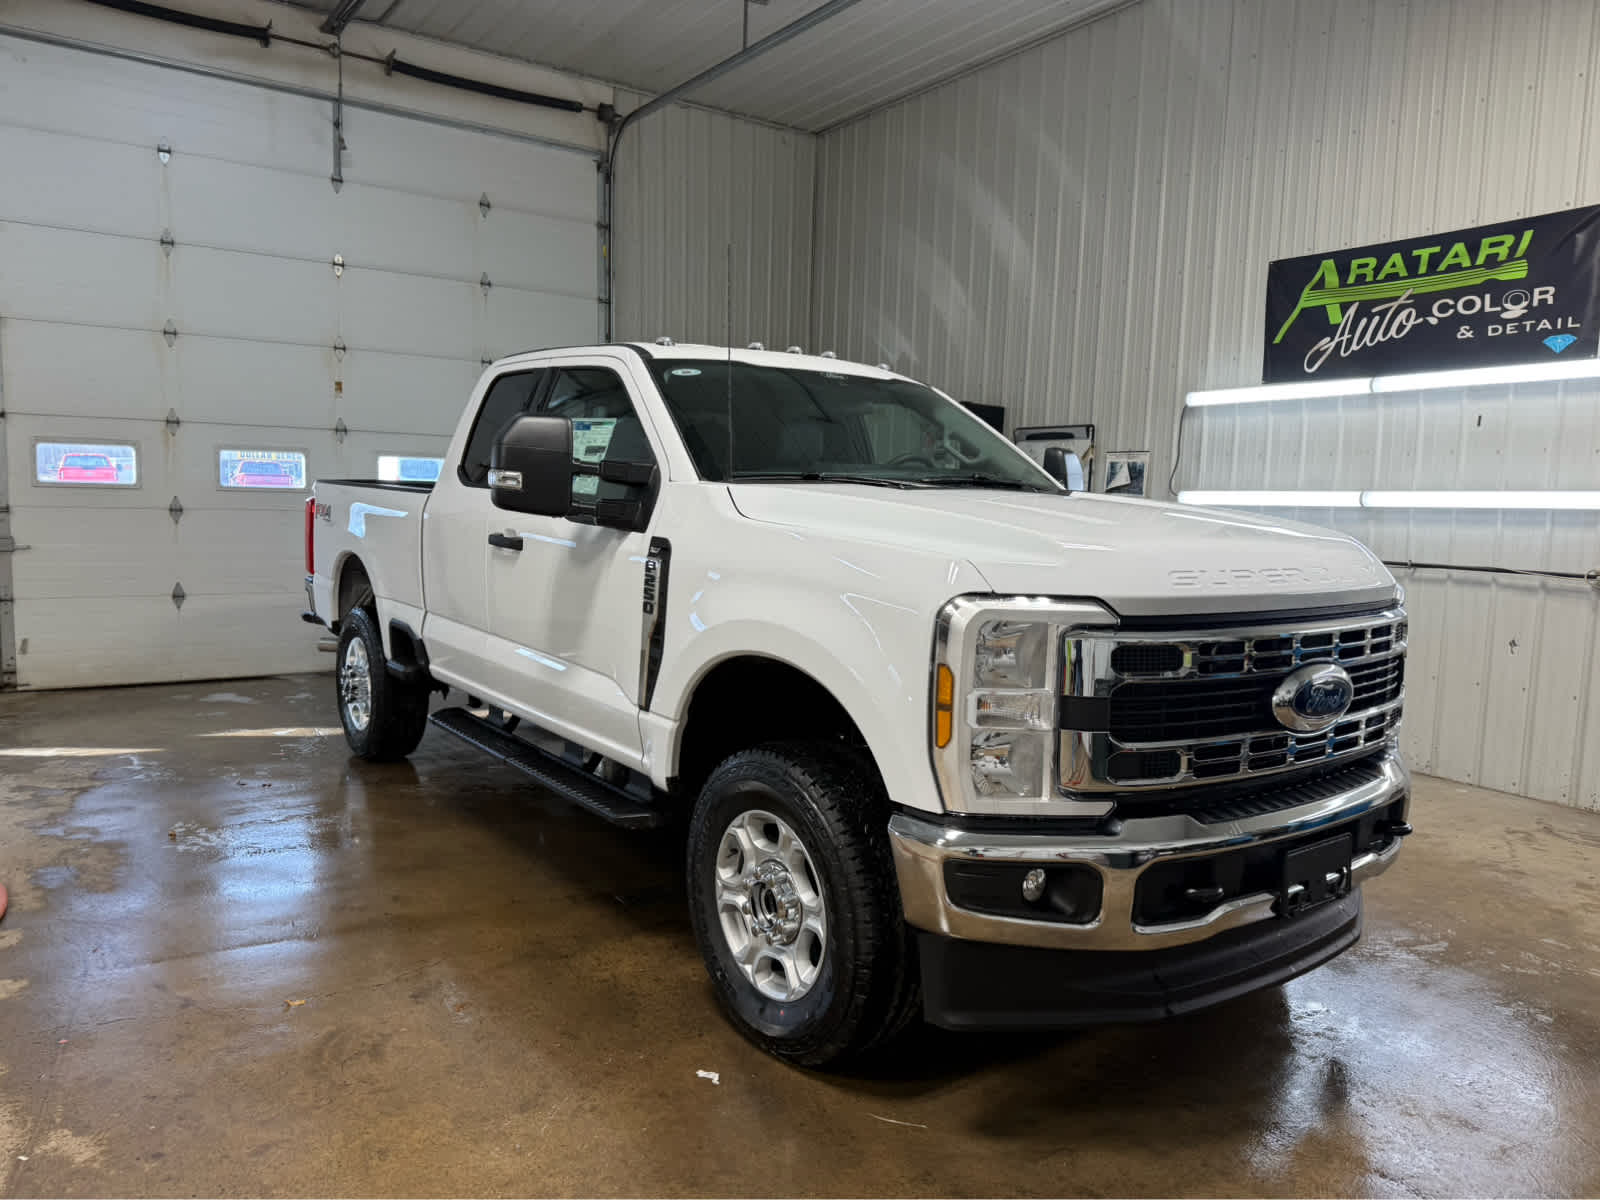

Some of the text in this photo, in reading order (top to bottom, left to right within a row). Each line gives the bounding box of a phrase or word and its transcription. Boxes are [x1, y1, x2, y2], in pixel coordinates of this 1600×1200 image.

[1273, 229, 1534, 344] ARATARI
[1303, 286, 1556, 373] Auto COLOR
[1456, 316, 1581, 339] & DETAIL
